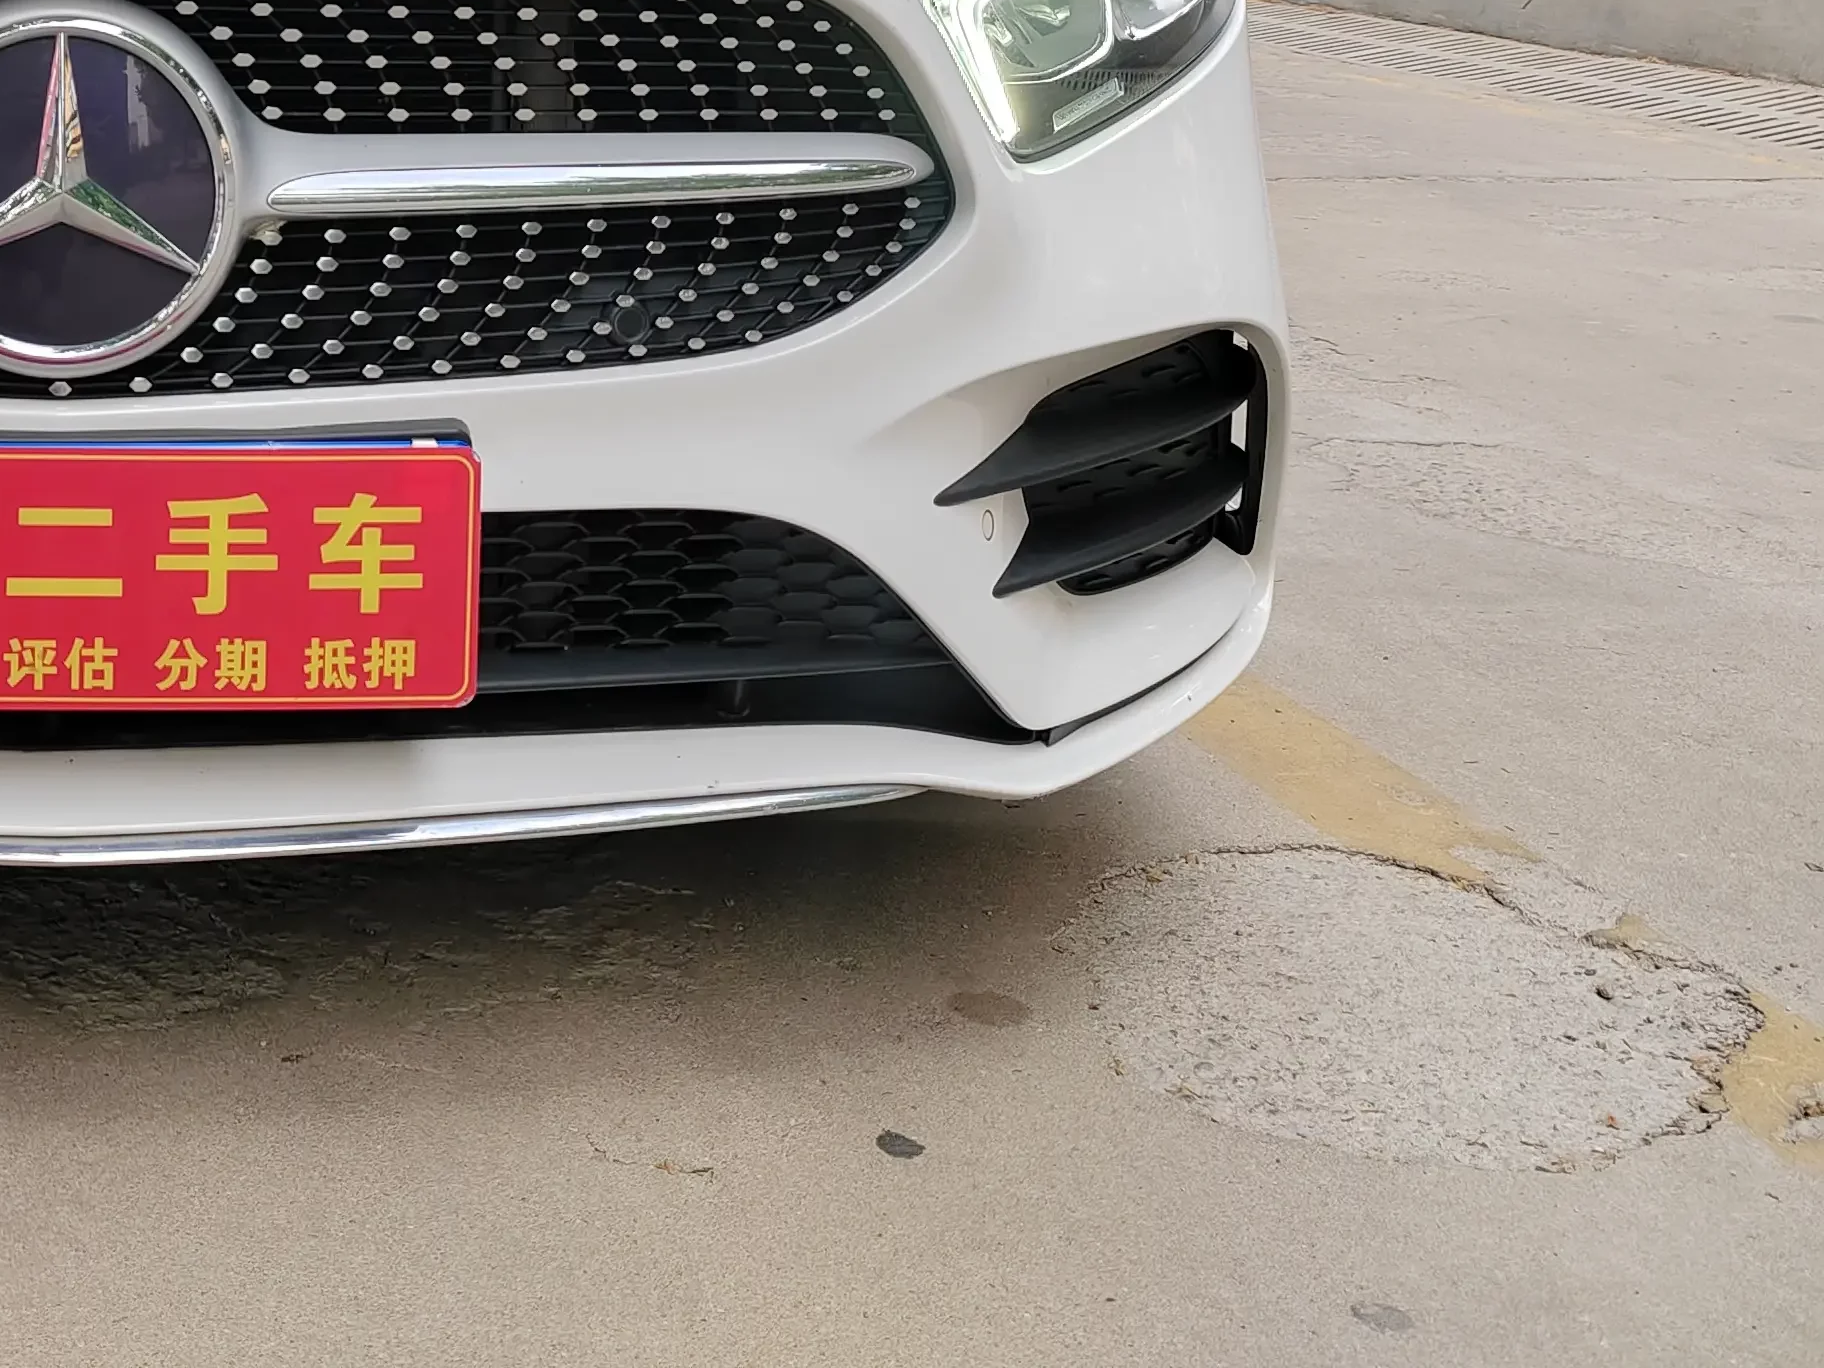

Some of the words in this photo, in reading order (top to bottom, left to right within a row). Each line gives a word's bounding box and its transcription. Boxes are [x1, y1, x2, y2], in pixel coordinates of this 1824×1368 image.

[4, 636, 118, 690] 评估
[154, 637, 267, 691] 分期
[303, 636, 416, 690] 抵押
